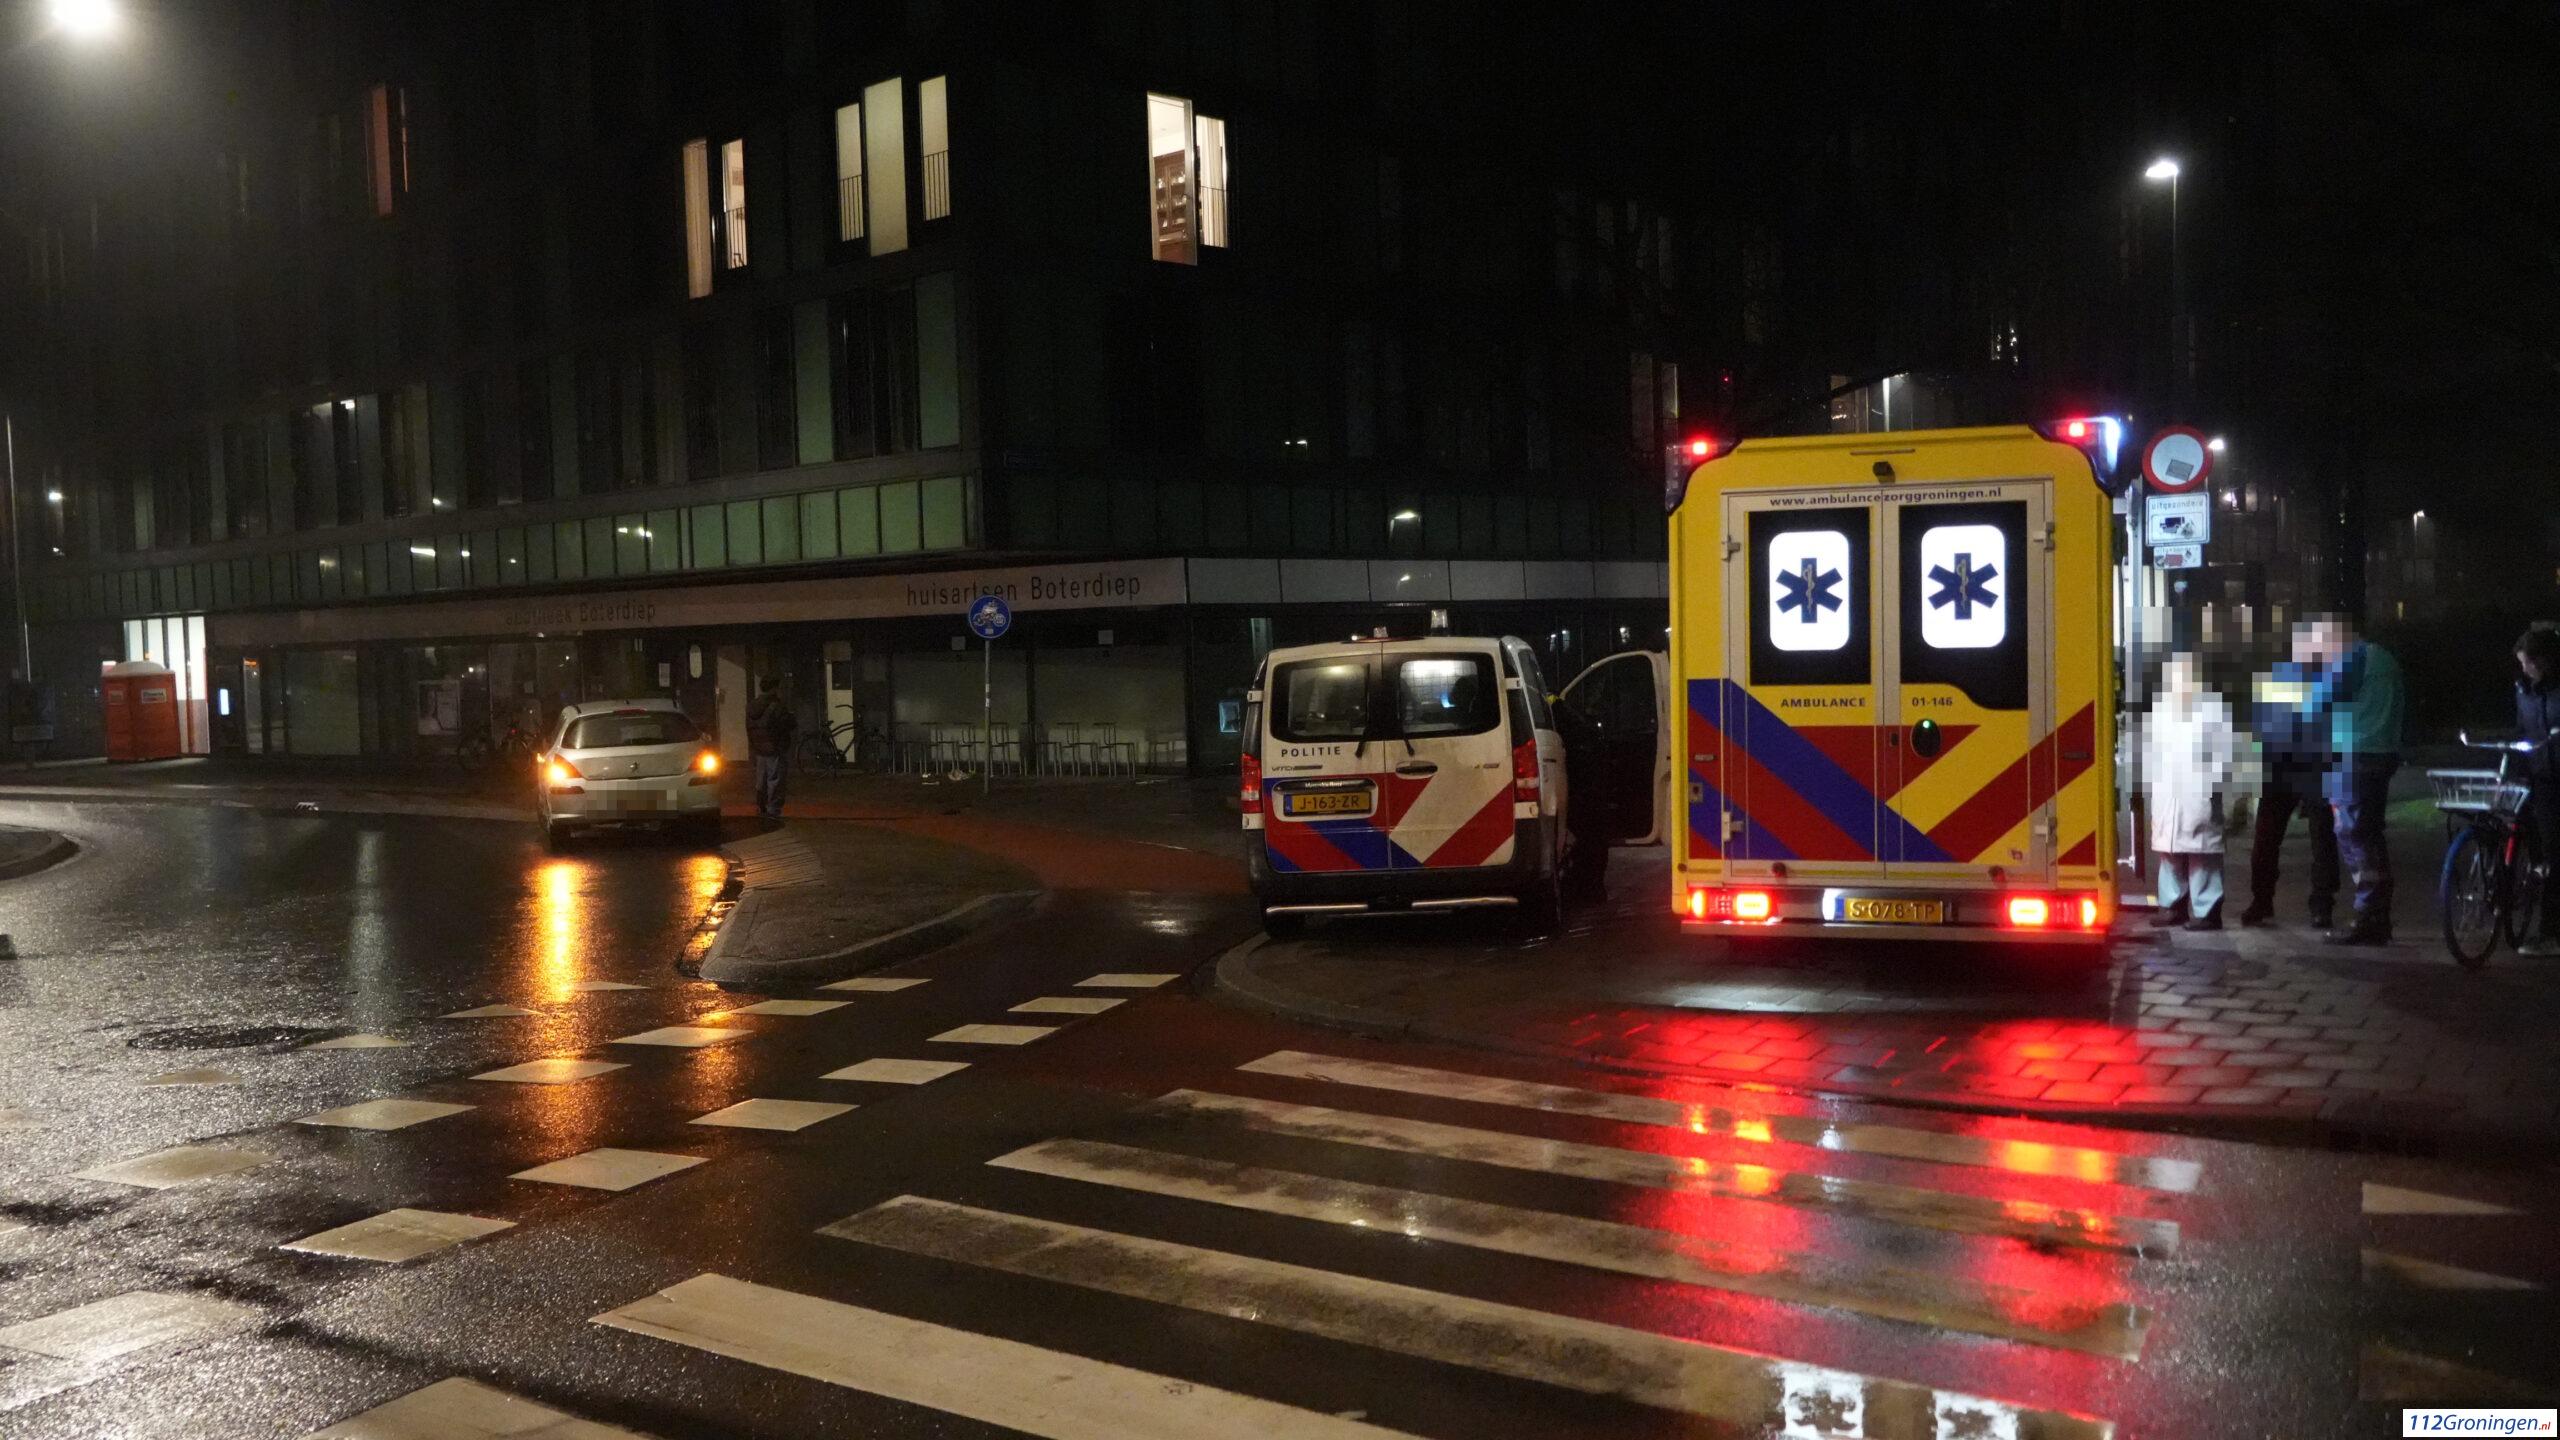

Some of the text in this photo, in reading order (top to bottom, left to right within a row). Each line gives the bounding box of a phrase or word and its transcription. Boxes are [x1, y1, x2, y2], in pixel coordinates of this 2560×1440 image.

[1769, 487, 2001, 506] www.ambulancezorggroningen.nl
[906, 572, 1140, 606] huisartsen Boterdiep
[580, 598, 655, 623] Boterdiep
[1780, 697, 1866, 708] AMBULANCE
[1911, 696, 1953, 707] 01-146
[1281, 746, 1341, 758] POLITIE
[1299, 795, 1361, 810] J-163-ZR
